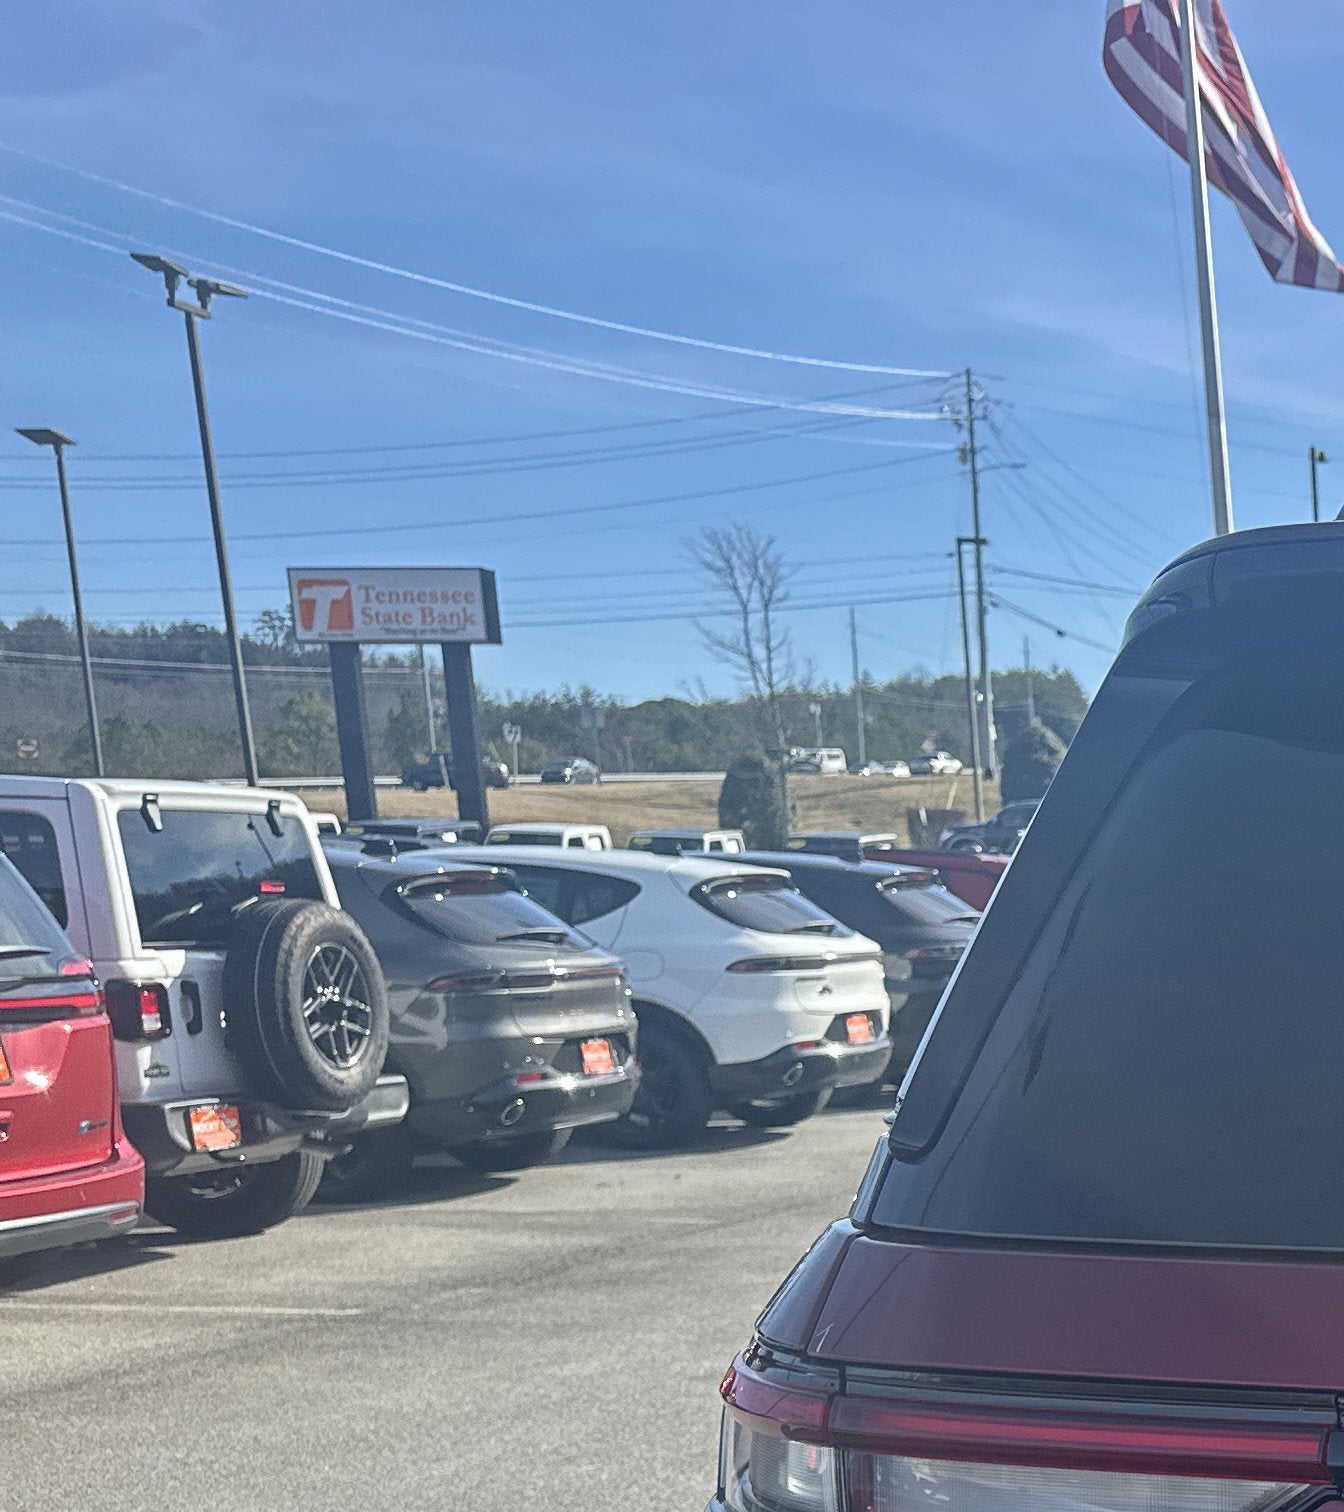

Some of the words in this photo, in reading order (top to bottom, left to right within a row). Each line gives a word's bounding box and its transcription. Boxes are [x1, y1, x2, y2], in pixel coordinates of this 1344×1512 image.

[357, 584, 476, 604] Tennessee
[361, 606, 413, 626] State
[420, 606, 476, 626] Bank
